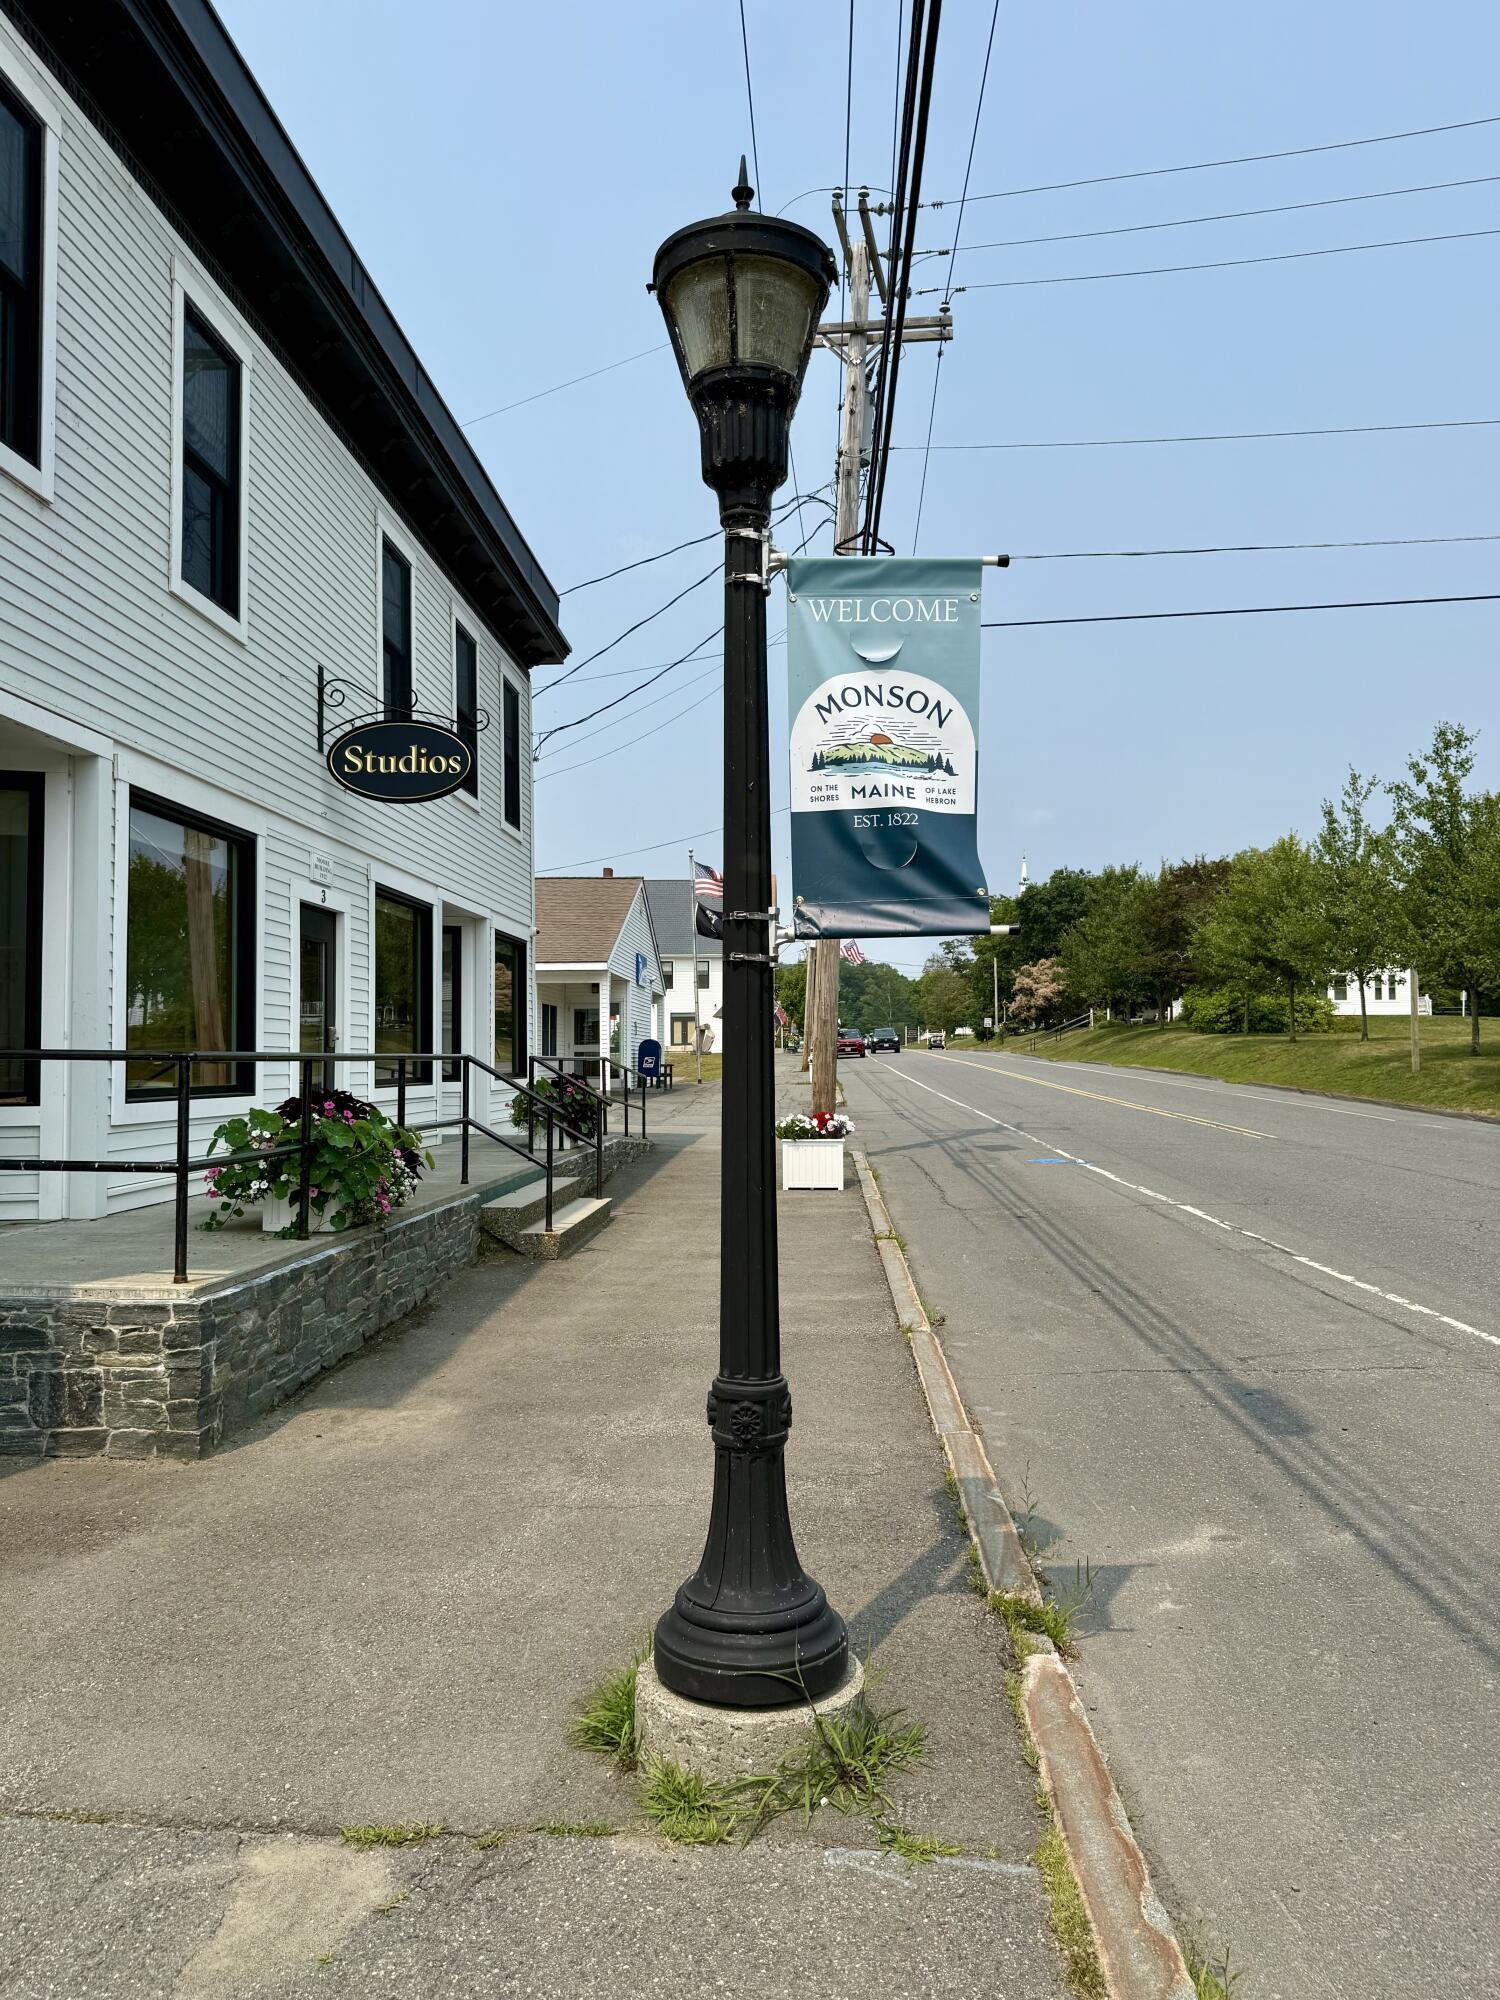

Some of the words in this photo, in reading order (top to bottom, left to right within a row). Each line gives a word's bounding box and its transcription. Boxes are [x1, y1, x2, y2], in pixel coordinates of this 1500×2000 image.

[807, 599, 959, 623] WELCOME
[813, 684, 953, 728] MONSON
[344, 744, 462, 774] Studios
[810, 785, 823, 793] ON
[825, 784, 839, 792] THE
[851, 783, 916, 800] MAINE
[925, 787, 935, 795] OF
[937, 787, 957, 795] LAKE
[810, 794, 840, 803] SHORES
[925, 796, 957, 805] HEBRON
[853, 814, 883, 828] EST.
[888, 813, 919, 827] 1822
[321, 889, 326, 904] 3
